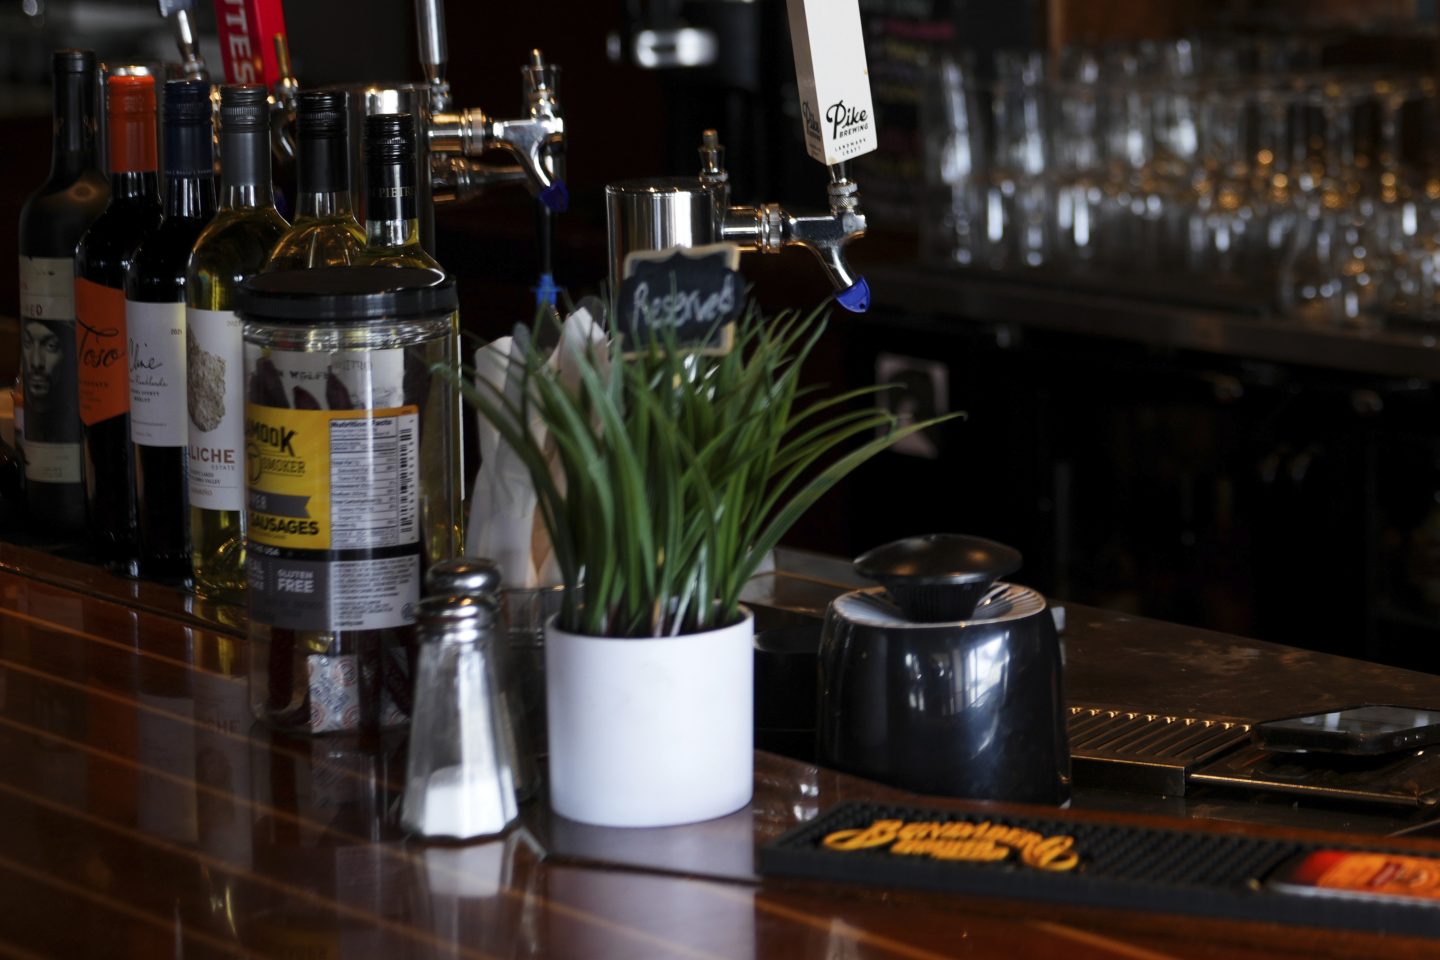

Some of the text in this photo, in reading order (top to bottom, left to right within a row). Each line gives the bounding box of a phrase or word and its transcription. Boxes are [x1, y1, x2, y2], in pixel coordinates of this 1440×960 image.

[826, 99, 868, 140] Pike
[839, 122, 869, 138] BREWING
[277, 578, 315, 593] FREE
